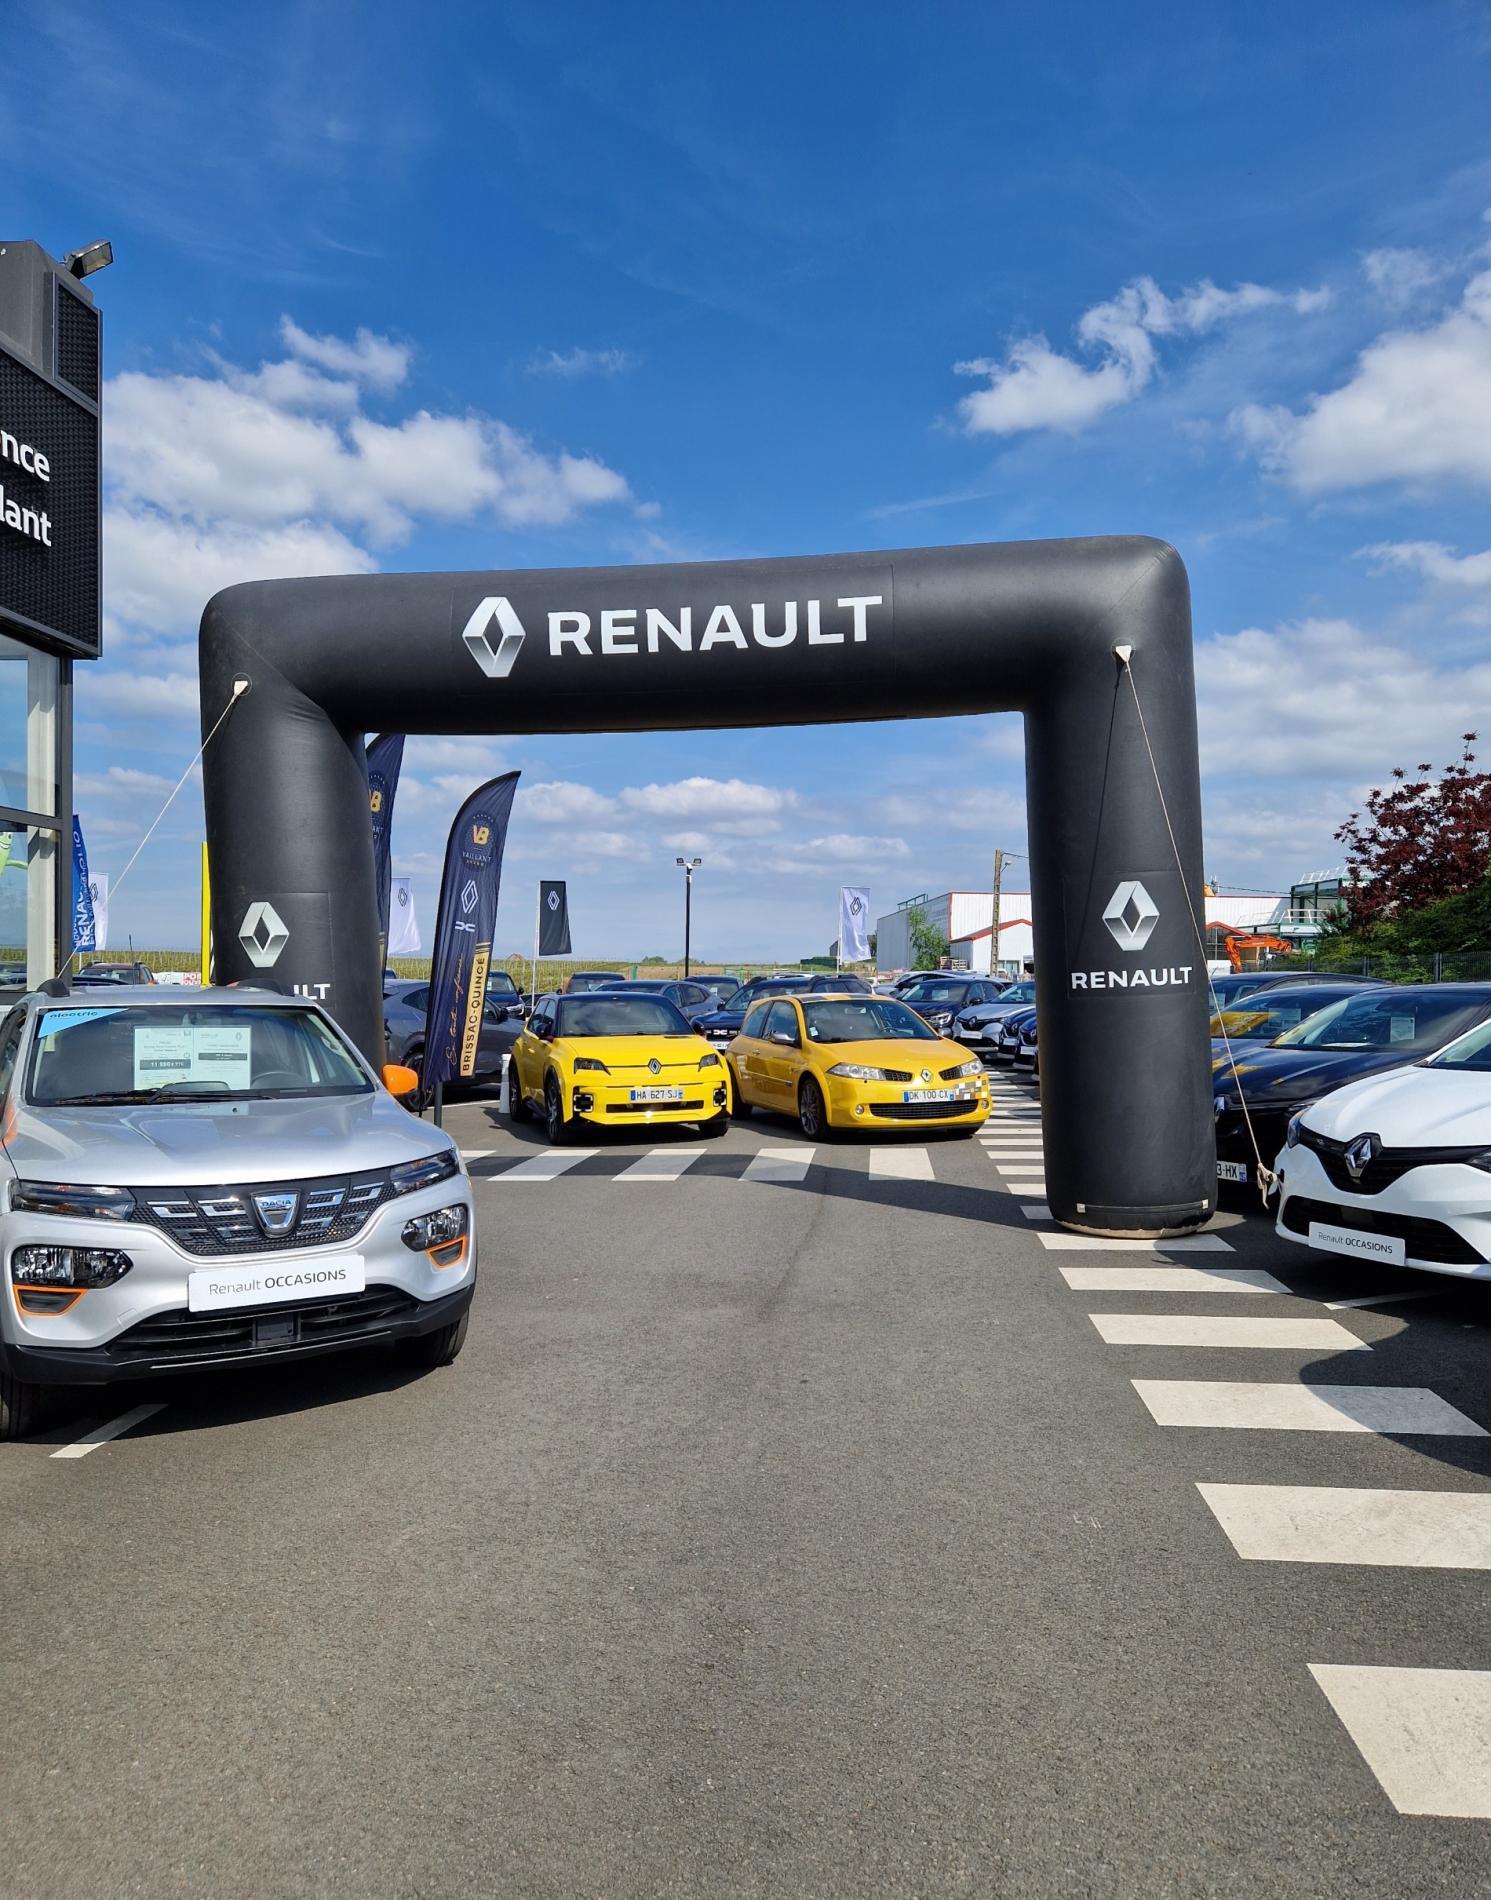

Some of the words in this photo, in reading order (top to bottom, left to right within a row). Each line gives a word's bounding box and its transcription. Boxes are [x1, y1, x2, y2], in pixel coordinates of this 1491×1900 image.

[547, 595, 883, 656] RENAULT
[462, 851, 492, 862] VAILLANT
[1071, 966, 1193, 990] RENAULT
[262, 1199, 292, 1207] DACIA
[1318, 1231, 1344, 1245] Renault
[1345, 1237, 1393, 1254] OCCASIONS
[209, 1279, 261, 1296] Renault
[264, 1269, 346, 1289] OCCASIONS
